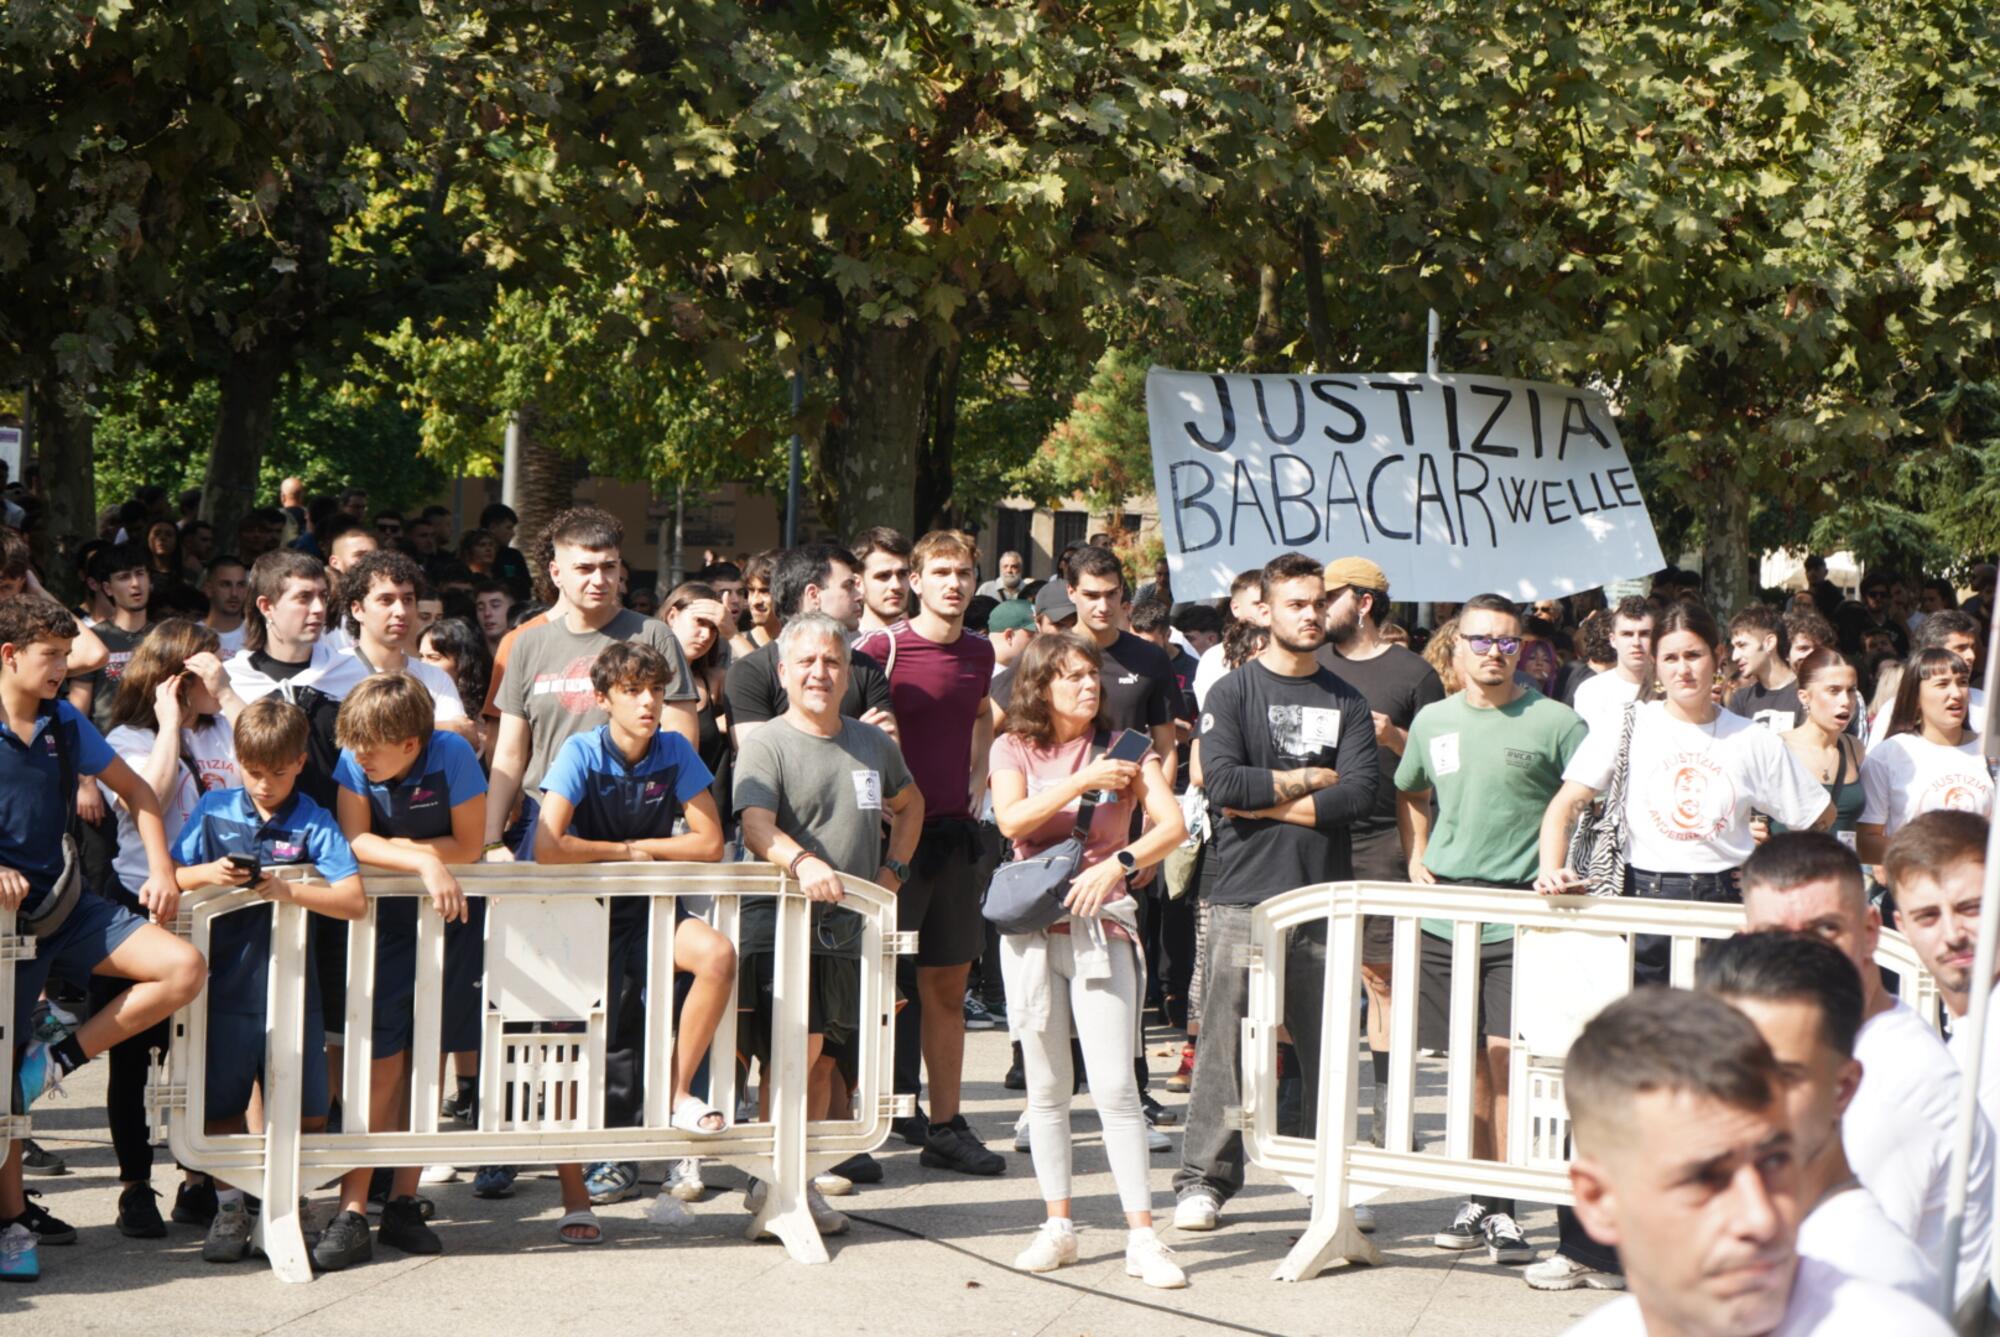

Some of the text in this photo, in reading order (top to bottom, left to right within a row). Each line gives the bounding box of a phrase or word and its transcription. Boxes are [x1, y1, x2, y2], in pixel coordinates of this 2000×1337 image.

[1183, 374, 1612, 461] JUSTIZIA
[1168, 450, 1643, 554] BABACAR WELLE
